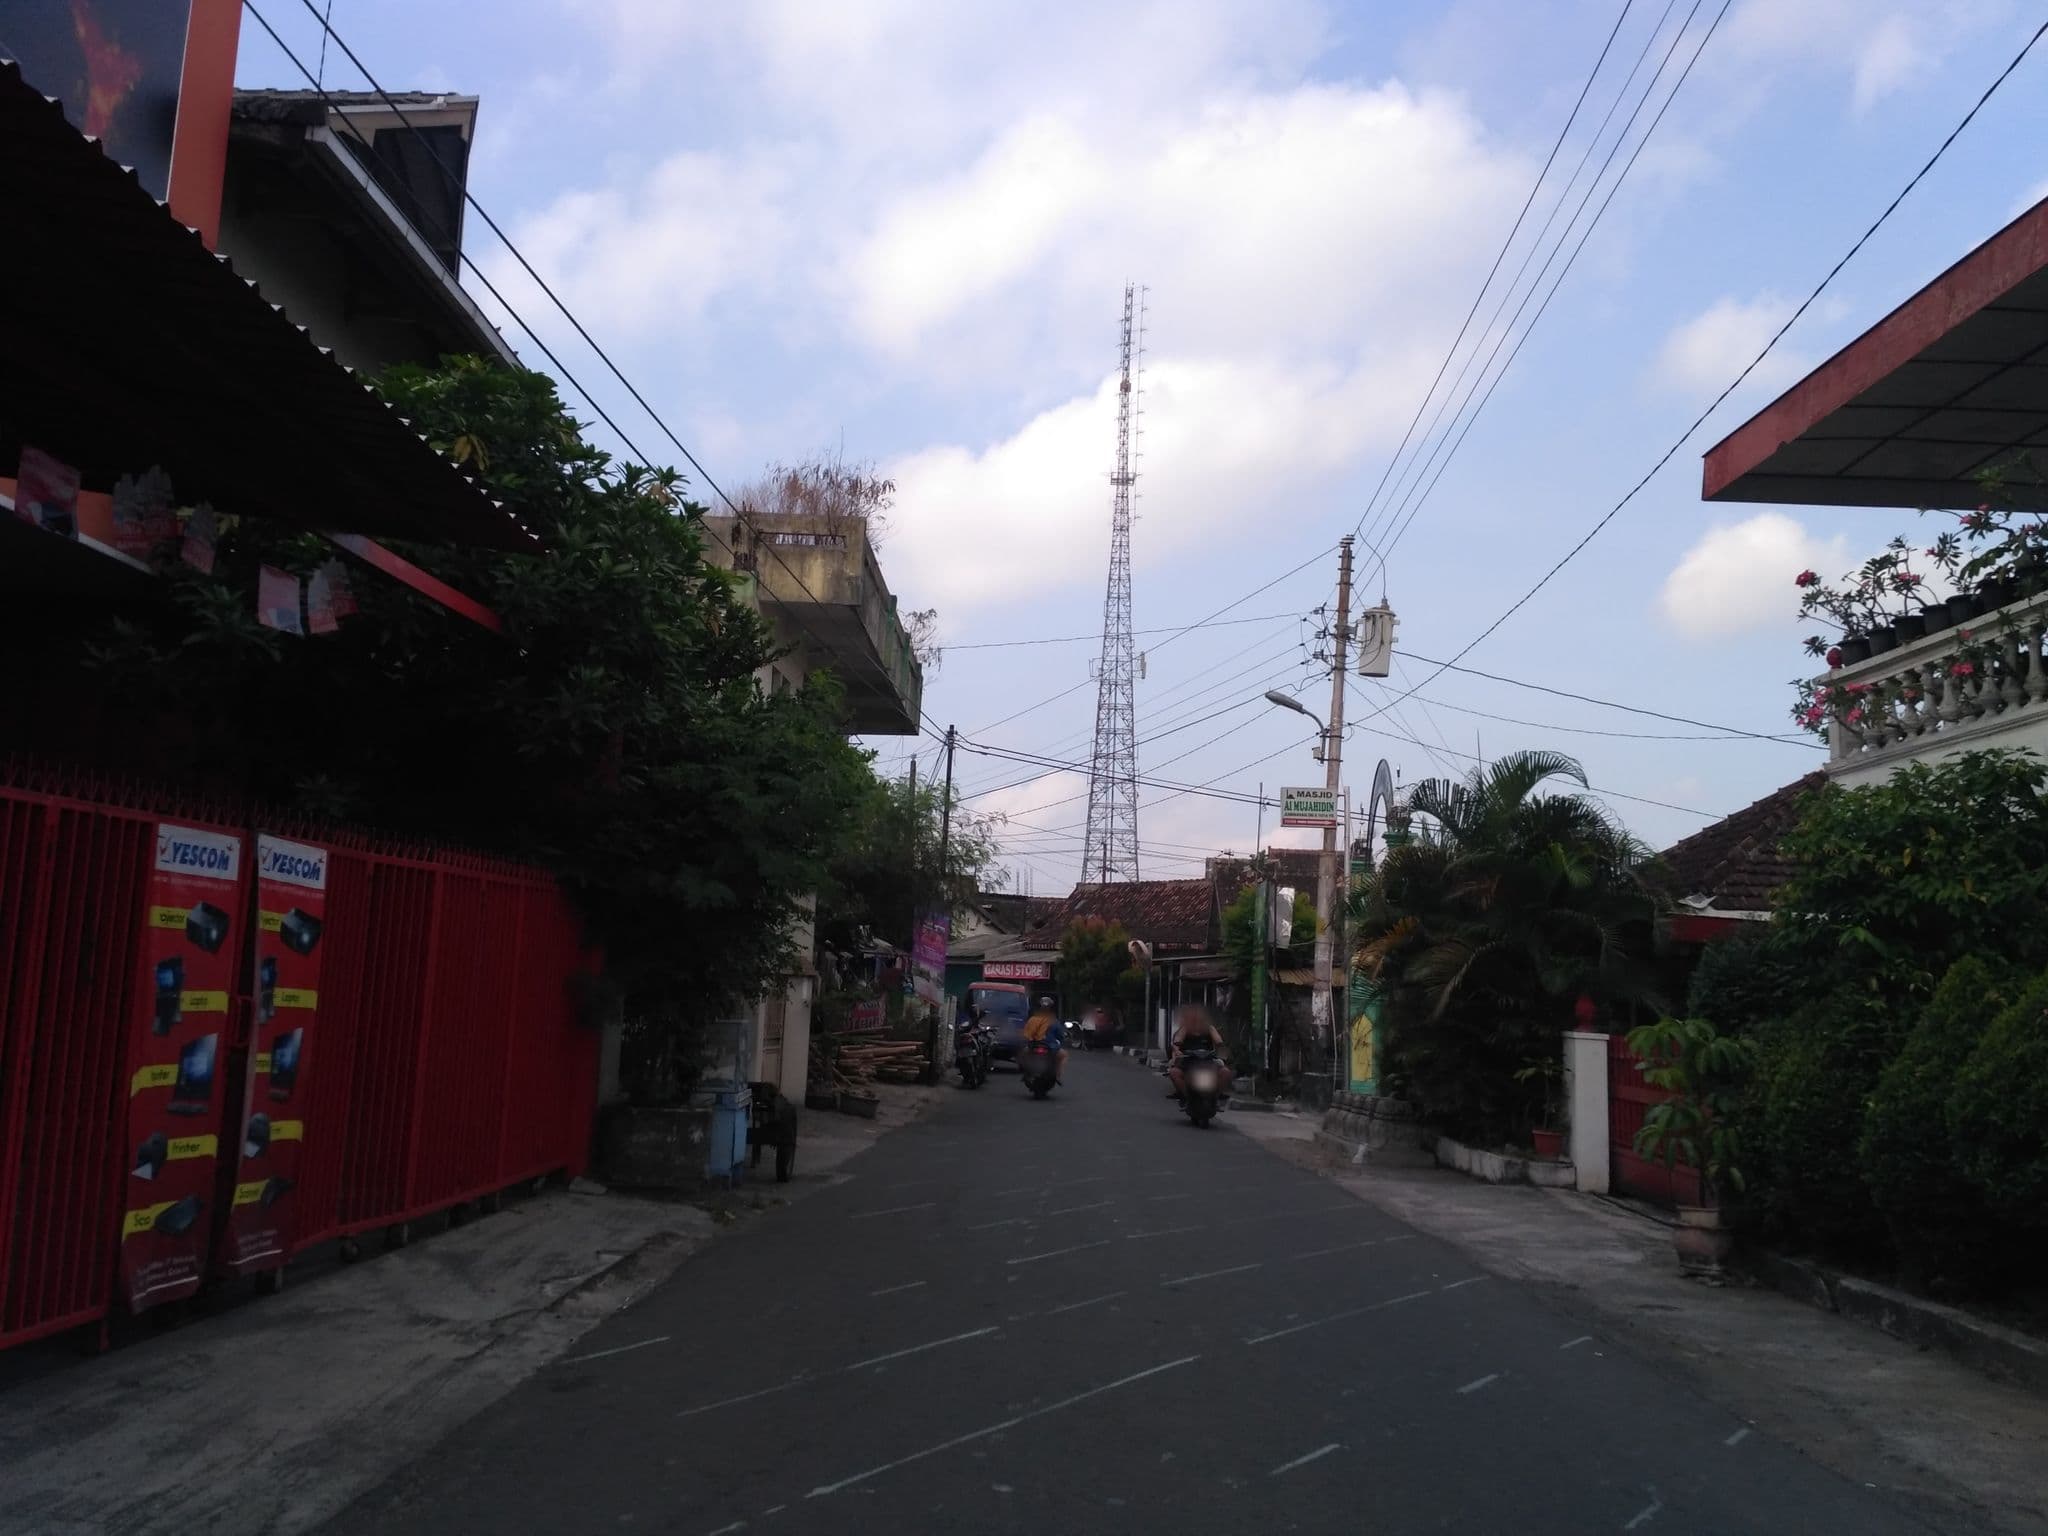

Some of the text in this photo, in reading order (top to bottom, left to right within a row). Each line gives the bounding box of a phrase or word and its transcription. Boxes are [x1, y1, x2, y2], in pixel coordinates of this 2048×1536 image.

[1297, 791, 1334, 799] MASJID
[1294, 801, 1336, 812] MUJAHIDIN
[172, 842, 231, 871] YESCOM
[271, 852, 321, 881] YESCOM
[984, 963, 1043, 977] GARASI STORE
